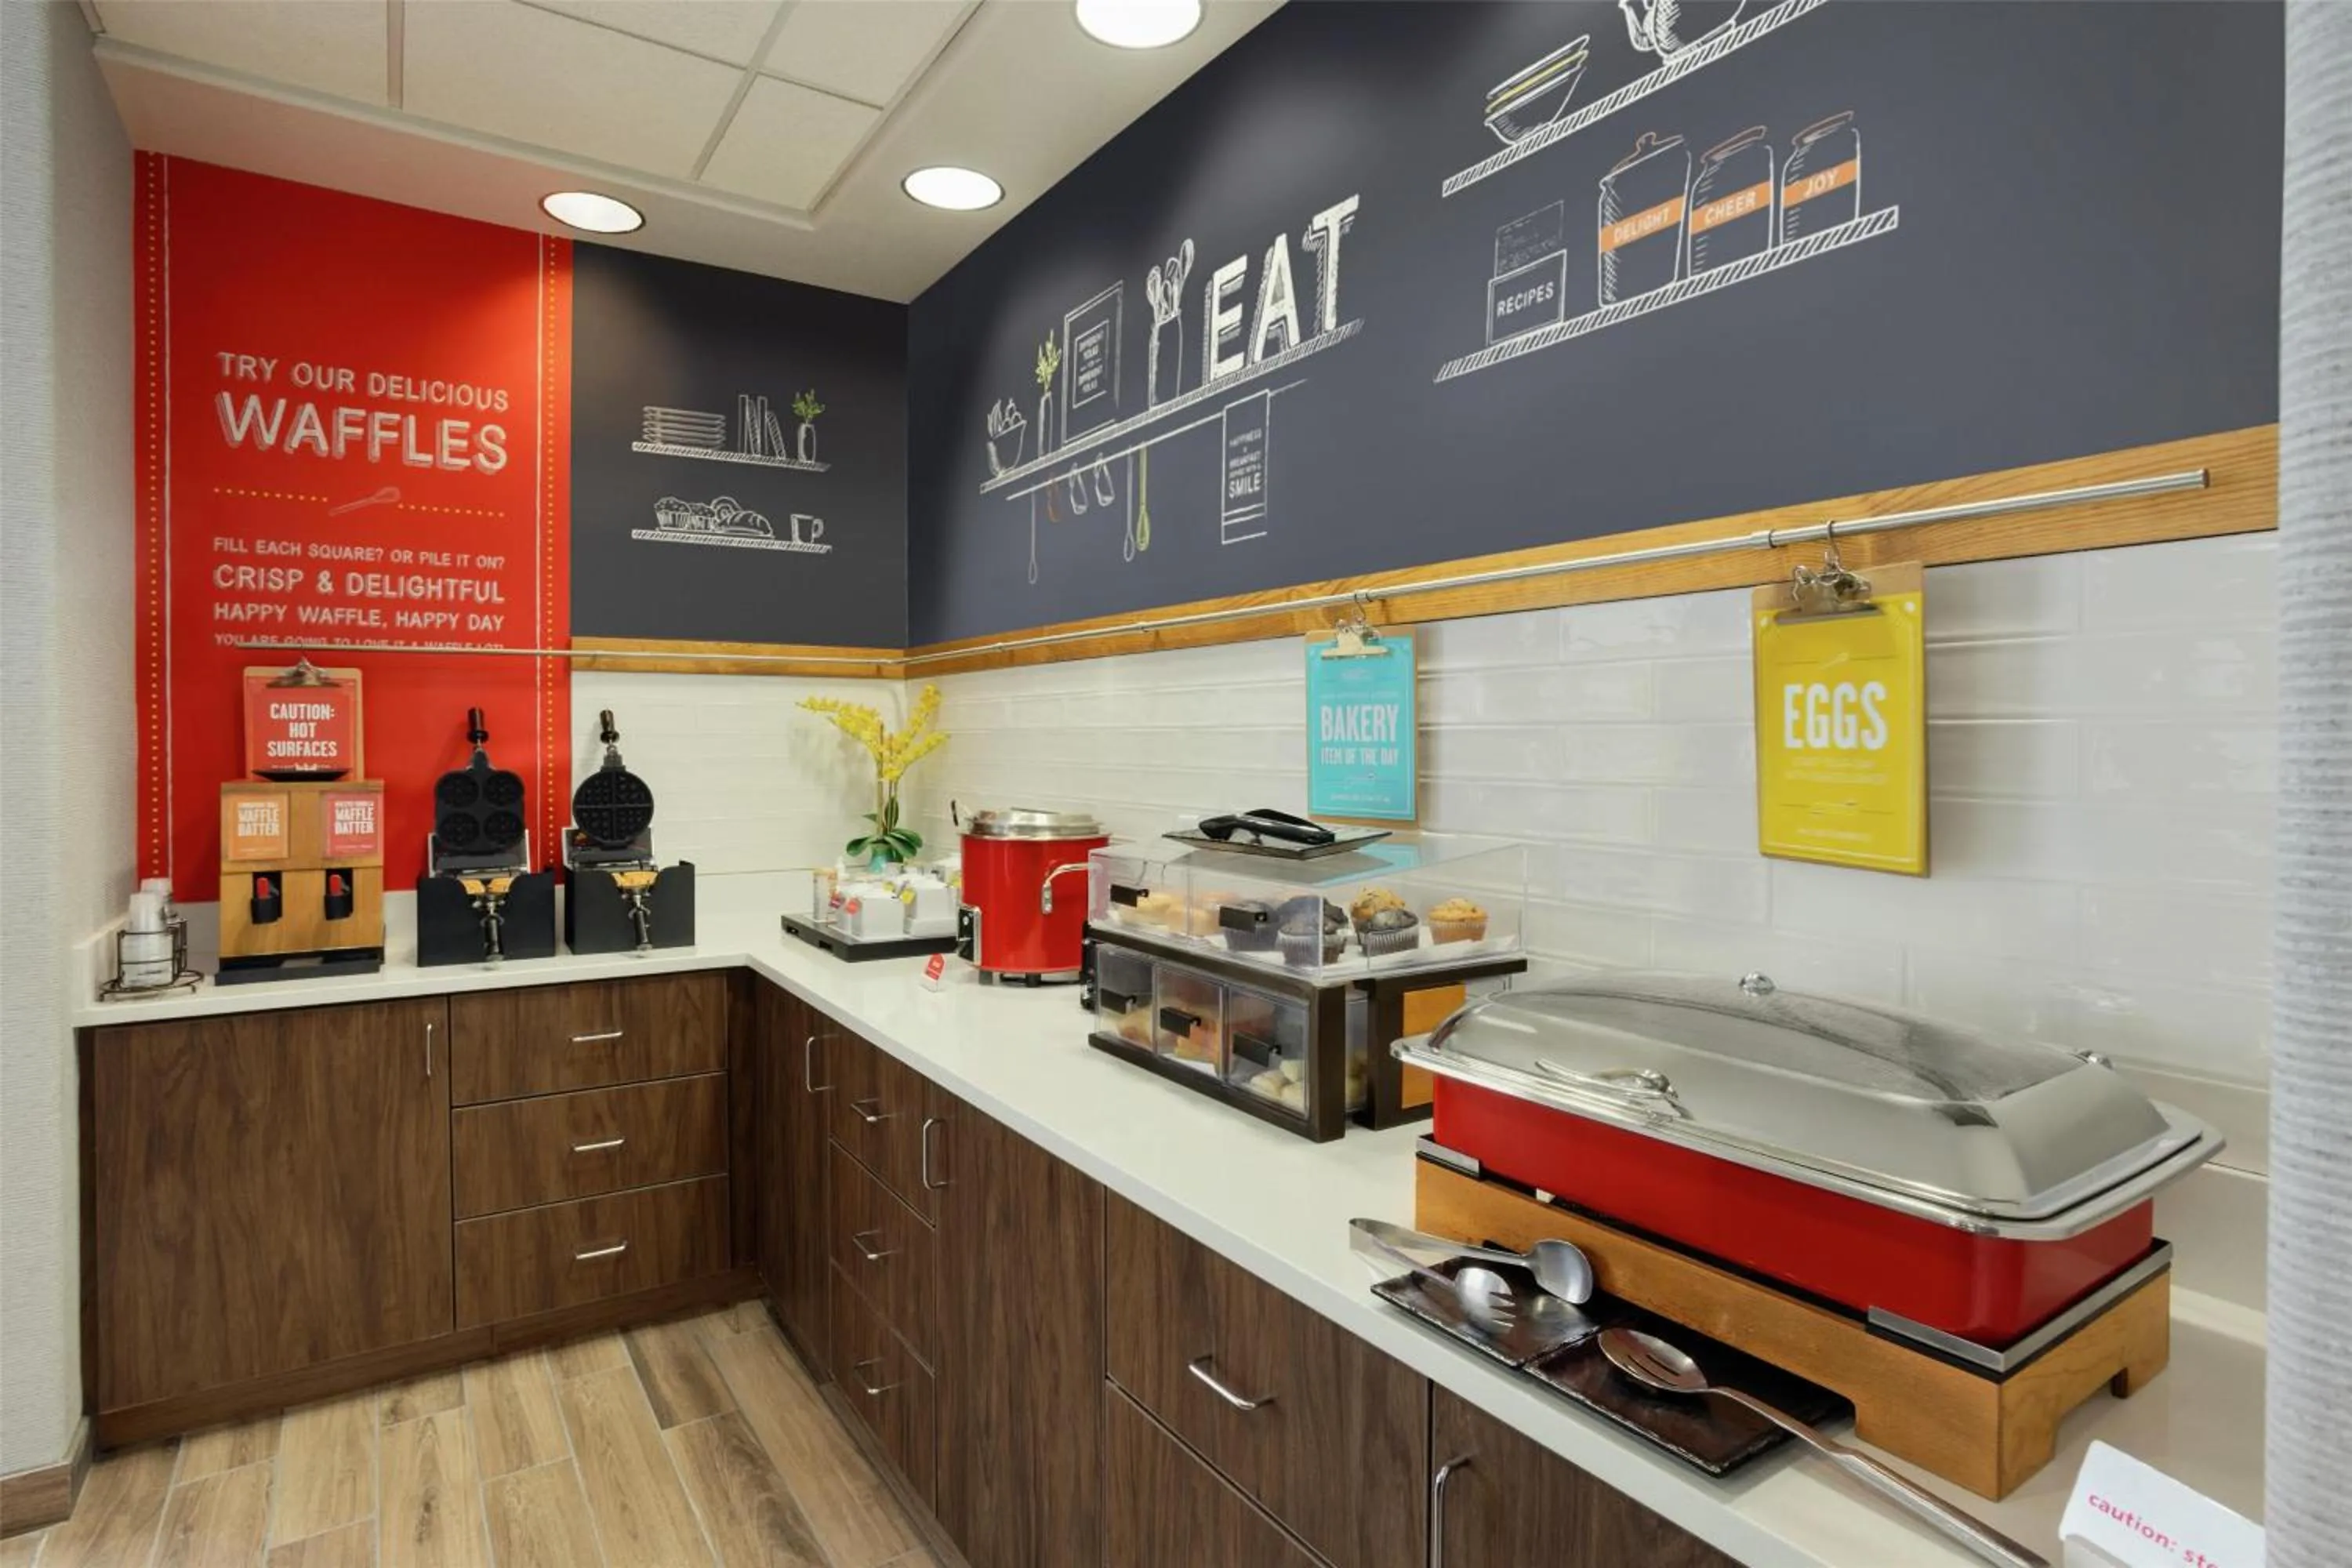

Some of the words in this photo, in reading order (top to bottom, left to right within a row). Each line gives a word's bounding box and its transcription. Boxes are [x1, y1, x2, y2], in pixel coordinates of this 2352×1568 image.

[1806, 169, 1838, 196] JOY
[1704, 191, 1756, 224] CHEER
[1613, 208, 1669, 242] DELIGHT
[1203, 194, 1359, 386] EAT
[1497, 281, 1554, 318] RECIPES
[218, 352, 278, 383] TRY
[292, 363, 354, 393] OUR
[368, 372, 509, 412] DELICIOUS
[215, 391, 508, 474] WAFFLES
[1229, 471, 1261, 499] SMILE
[213, 537, 248, 553] FILL
[255, 539, 301, 556] EACH
[307, 543, 383, 562] SQUARE?
[390, 550, 413, 564] OR
[419, 551, 452, 566] PILE
[456, 554, 470, 568] IT
[476, 555, 505, 570] ON?
[213, 564, 305, 593] CRISP
[316, 570, 334, 596] &
[347, 572, 506, 604] DELIGHTFUL
[213, 602, 288, 623] HAPPY
[297, 605, 387, 630] WAFFLE,
[395, 609, 460, 630] HAPPY
[468, 613, 505, 632] DAY
[214, 633, 244, 645] YOU
[250, 634, 279, 644] ARE
[270, 702, 335, 720] CAUTION:
[1320, 704, 1399, 742] BAKERY
[1784, 681, 1888, 751] EGGS
[289, 721, 317, 738] HOT
[267, 741, 337, 757] SURFACES
[1360, 747, 1377, 766] THE
[1381, 747, 1398, 766] DAY
[238, 808, 280, 822] WAFFLE
[335, 807, 374, 821] WAFFLE
[335, 821, 374, 835] BATTER
[238, 822, 280, 837] BATTER
[2089, 1494, 2178, 1552] caution:
